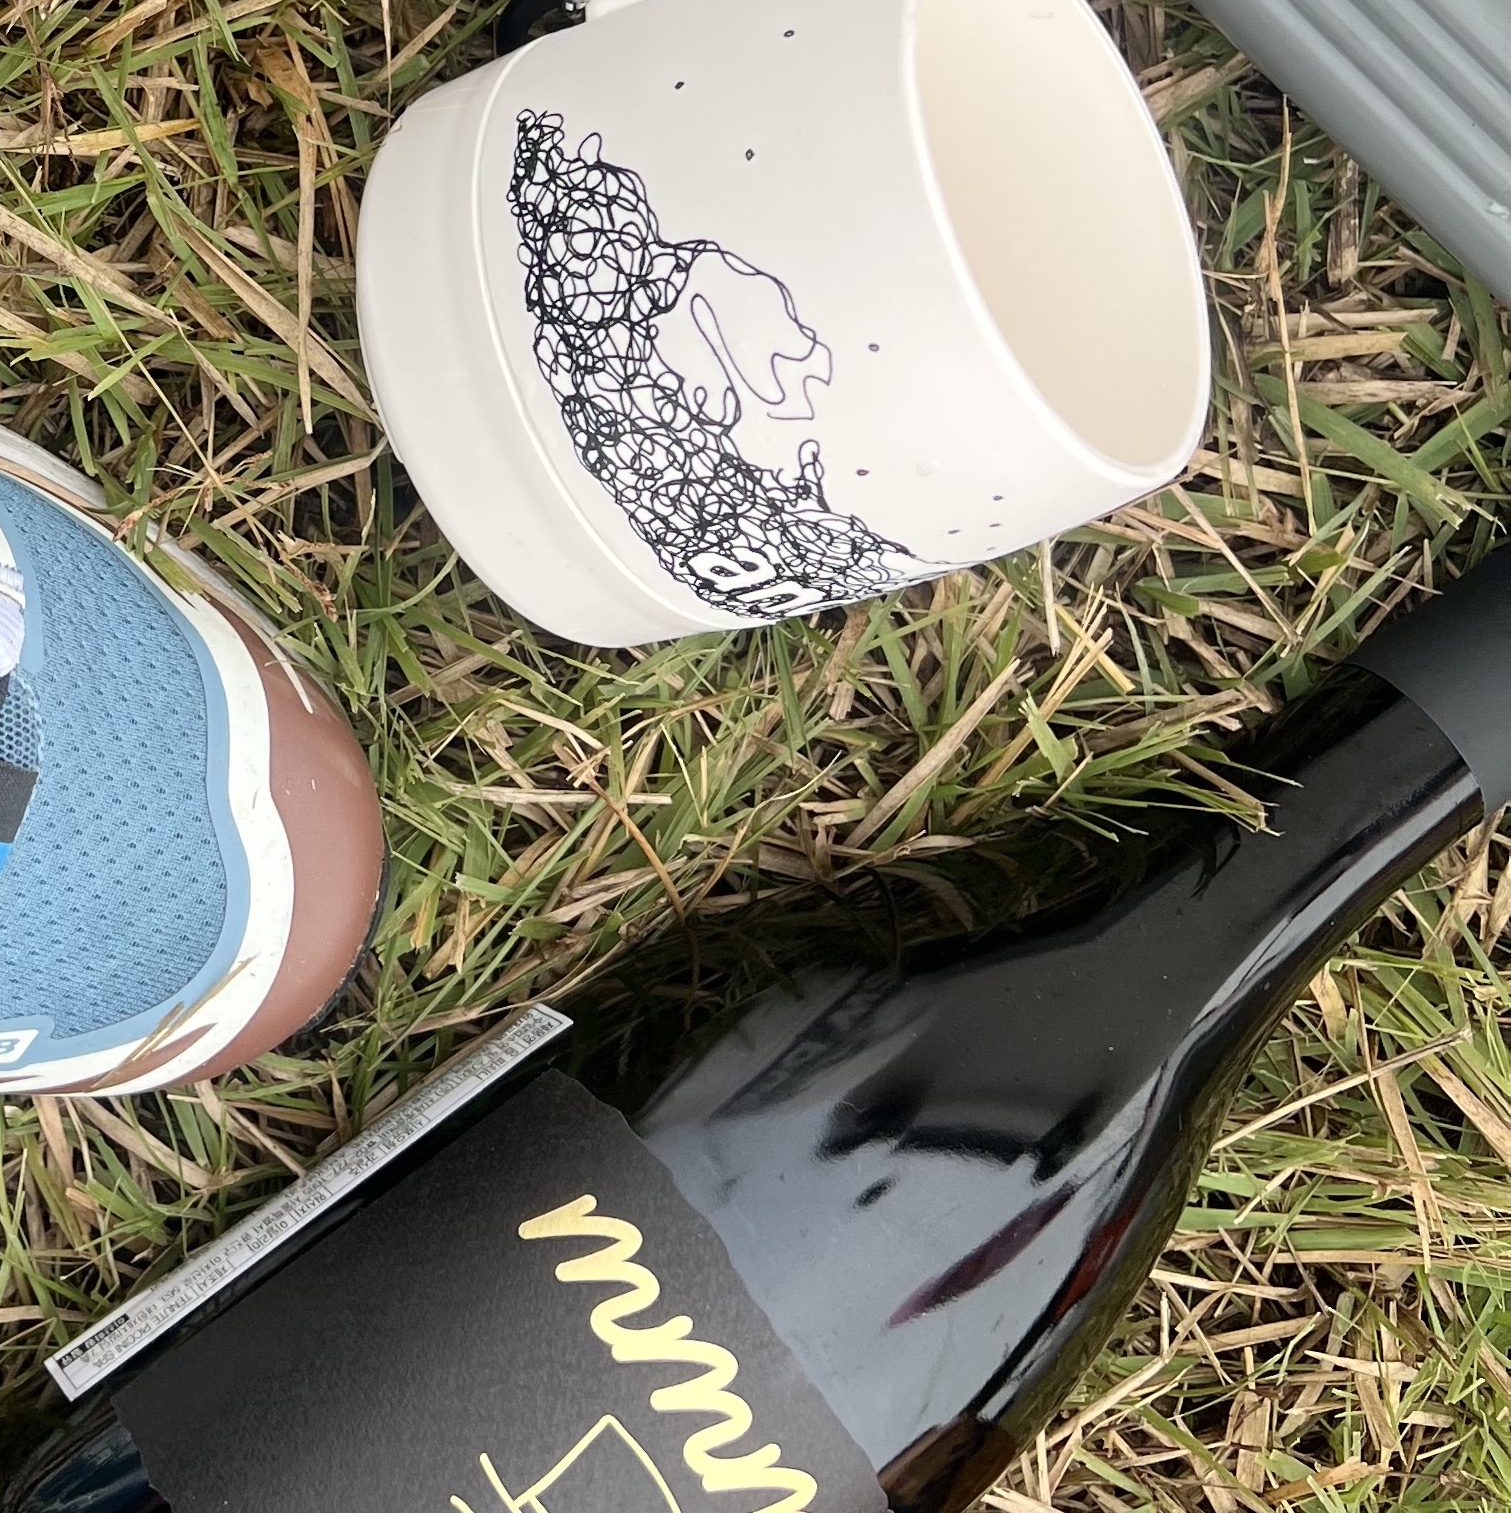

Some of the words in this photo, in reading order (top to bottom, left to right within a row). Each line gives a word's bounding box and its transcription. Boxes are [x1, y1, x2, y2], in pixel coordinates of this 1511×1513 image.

[346, 1149, 379, 1178] 과실주
[293, 1190, 325, 1218] 원산지
[245, 1218, 288, 1253] 이탈리아
[195, 1263, 228, 1291] 제조사
[150, 1291, 192, 1326] TENUTE
[113, 1321, 151, 1353] PICCINI
[91, 1349, 115, 1370] SPA
